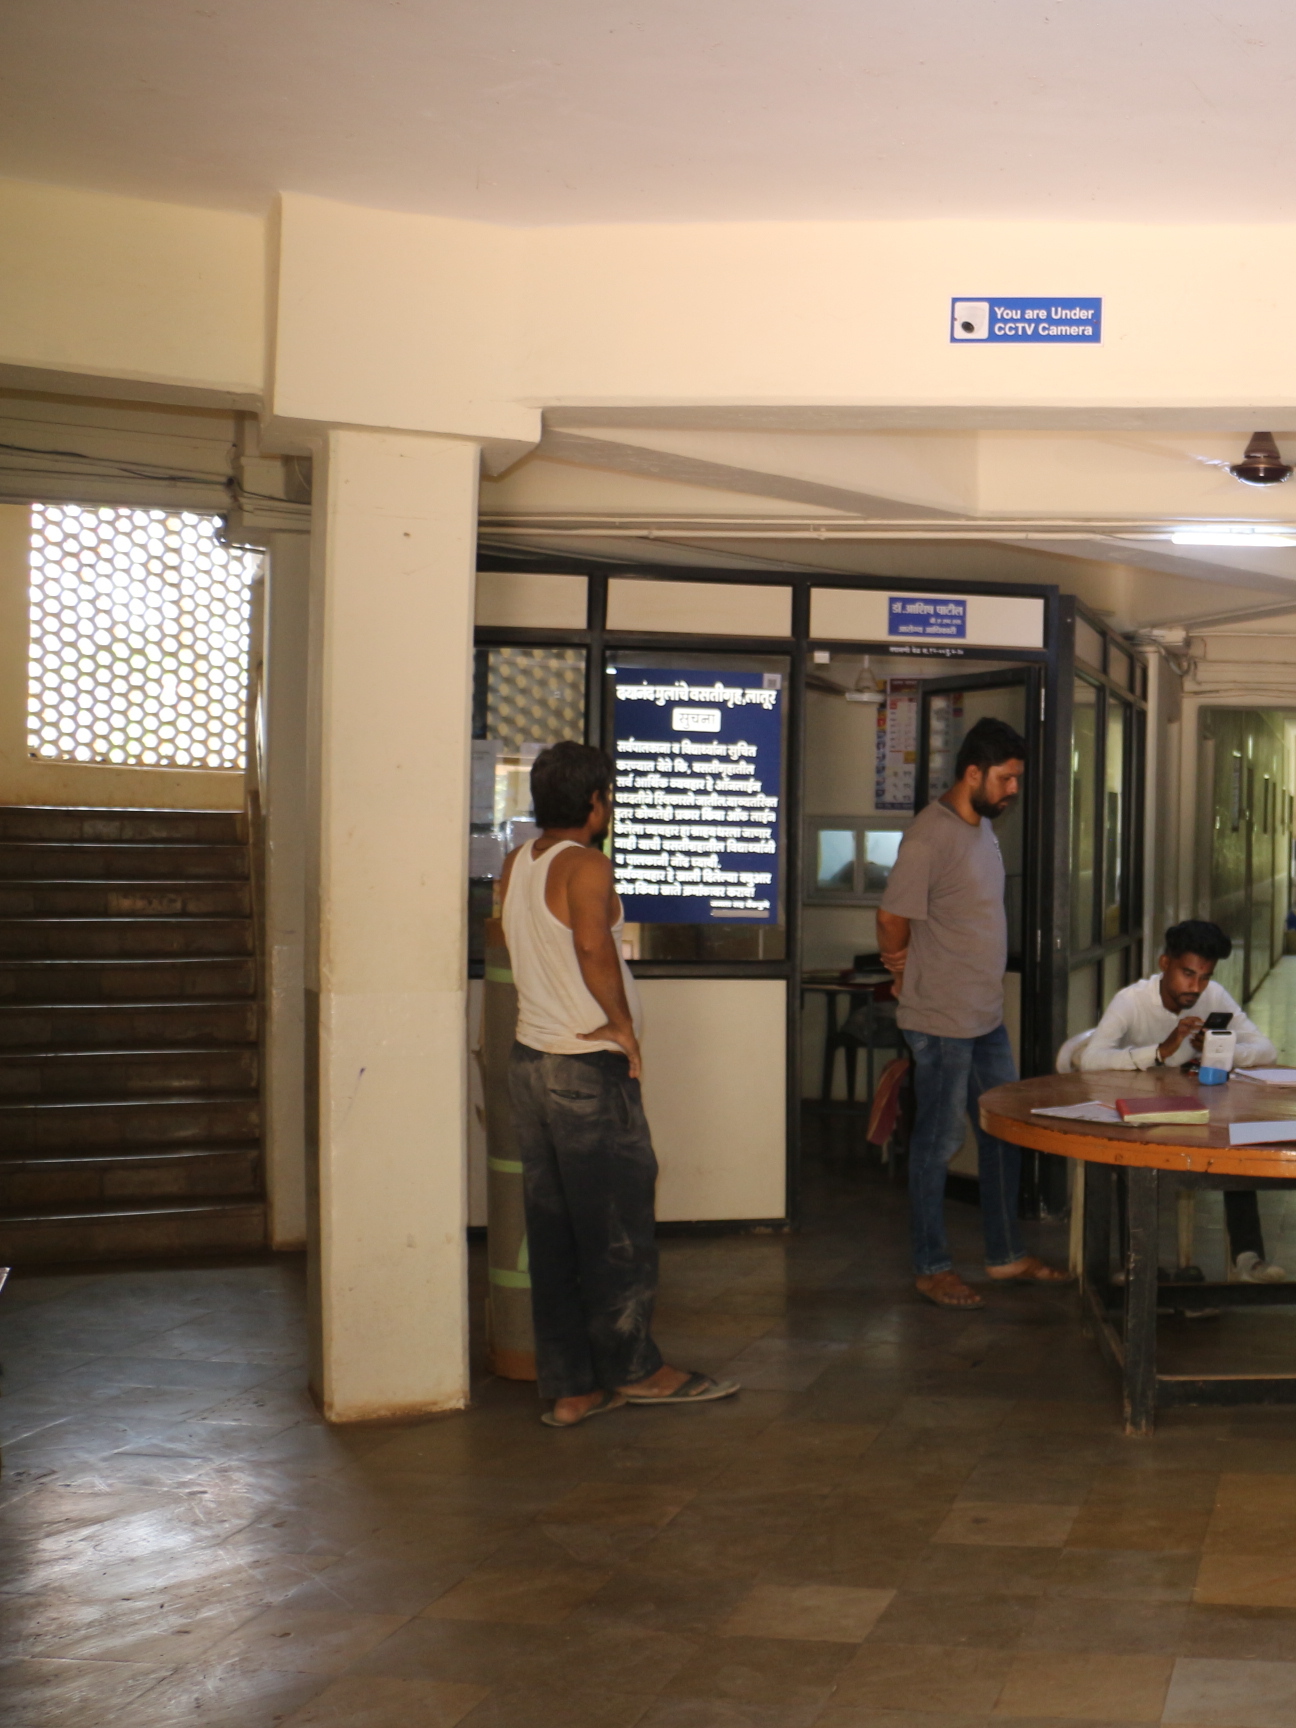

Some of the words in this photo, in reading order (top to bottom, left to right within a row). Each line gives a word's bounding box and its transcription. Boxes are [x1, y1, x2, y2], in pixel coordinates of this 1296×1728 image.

[994, 307, 1021, 320] You
[1024, 309, 1047, 320] are
[1051, 307, 1094, 320] Under
[994, 323, 1035, 336] CCTV
[1038, 323, 1093, 336] Camera
